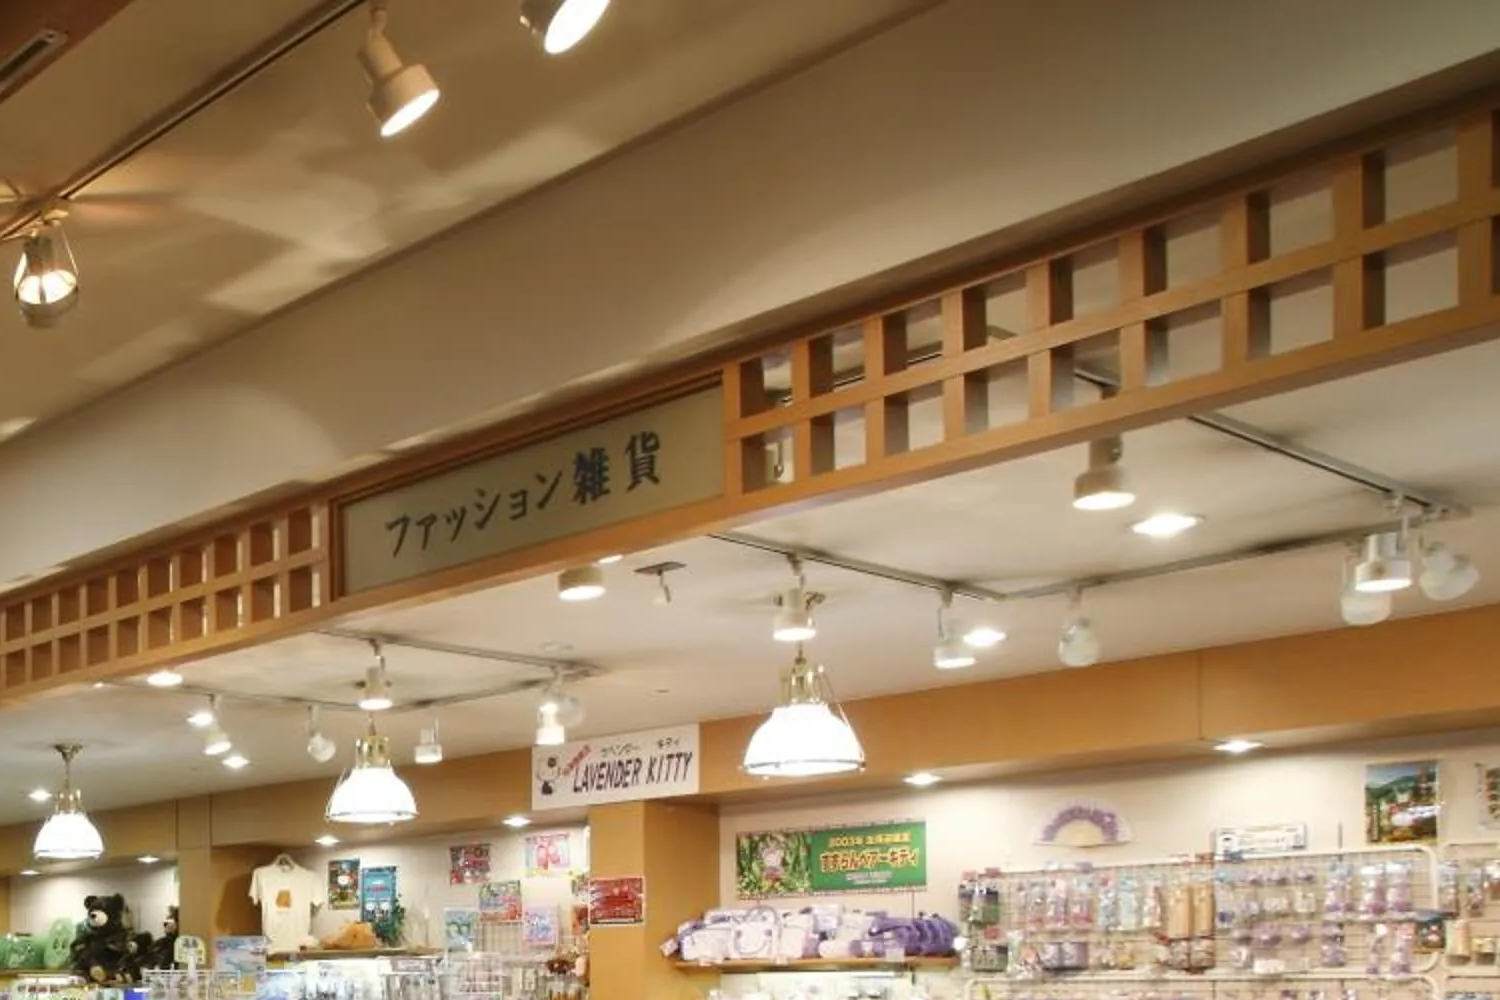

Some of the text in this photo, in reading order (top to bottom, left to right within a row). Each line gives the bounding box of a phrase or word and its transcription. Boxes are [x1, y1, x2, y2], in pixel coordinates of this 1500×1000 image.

[386, 431, 661, 558] ファッション雑貨
[573, 757, 643, 793] LAVENDER
[645, 751, 693, 785] KITTY
